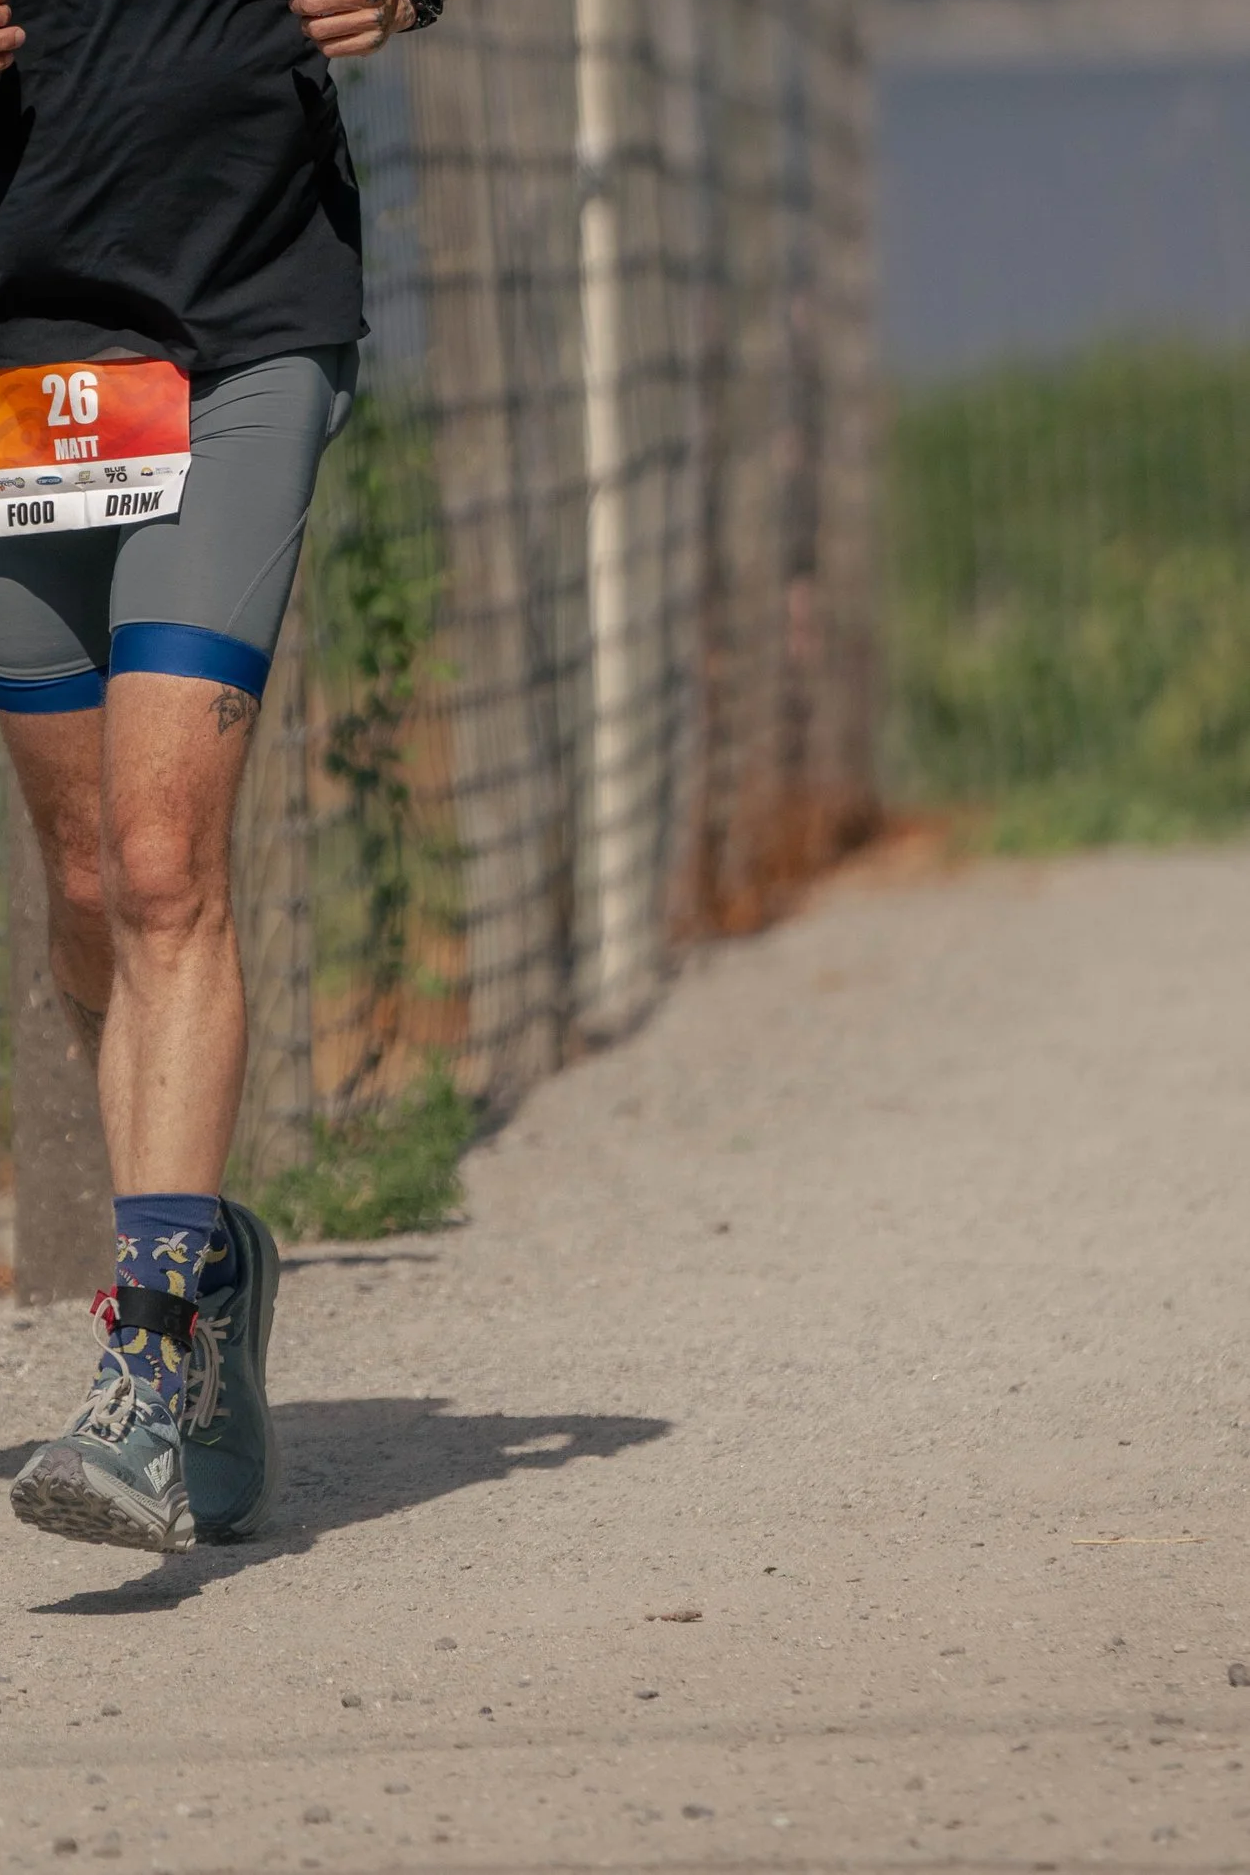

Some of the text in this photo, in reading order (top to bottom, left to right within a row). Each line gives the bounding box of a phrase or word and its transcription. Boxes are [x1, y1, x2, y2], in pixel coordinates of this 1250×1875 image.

[42, 371, 98, 427] 26
[54, 435, 98, 461] MATT
[104, 466, 126, 474] BLUE
[106, 472, 128, 484] 70
[7, 490, 163, 527] FOOD DRINK
